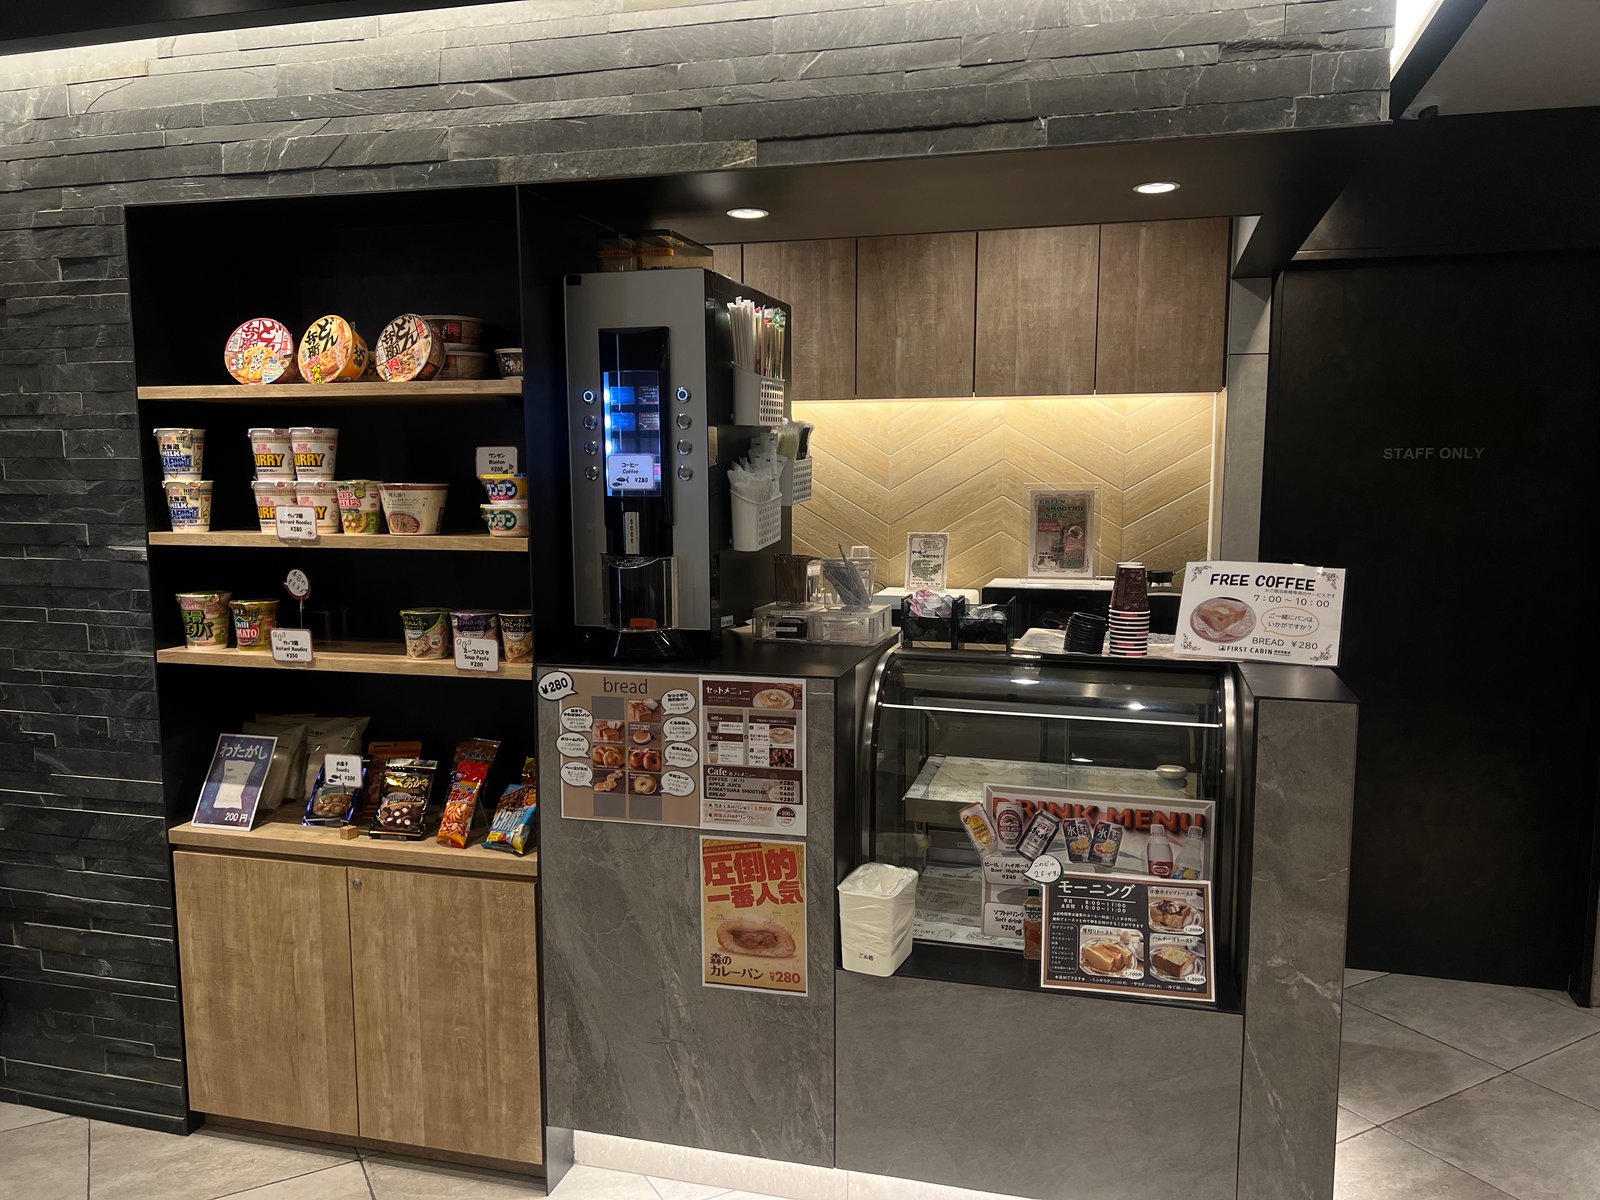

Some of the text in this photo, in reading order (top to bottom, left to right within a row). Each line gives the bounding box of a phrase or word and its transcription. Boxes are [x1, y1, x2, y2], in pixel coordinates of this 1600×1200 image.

[255, 453, 285, 467] URRY
[294, 453, 325, 467] URRY
[1383, 447, 1485, 459] STAFF ONLY
[1210, 573, 1316, 592] FREE COFFEE
[1268, 612, 1314, 623] ご一緒にパンは
[1226, 645, 1248, 653] FIRST
[1250, 647, 1273, 655] CABIN
[1252, 637, 1318, 650] BREAD ¥280
[540, 677, 569, 695] ¥280
[603, 676, 648, 694] bread
[706, 686, 750, 695] セットメニュー
[220, 742, 268, 760] わたがし
[707, 767, 727, 776] Cafe
[703, 847, 798, 887] 圧倒的
[707, 880, 804, 909] 一番人気
[1058, 880, 1136, 899] モーニング
[993, 909, 1024, 918] ソフトドリンク
[710, 953, 732, 965] 森の
[710, 965, 764, 980] カレーパン
[770, 971, 801, 984] ¥280
